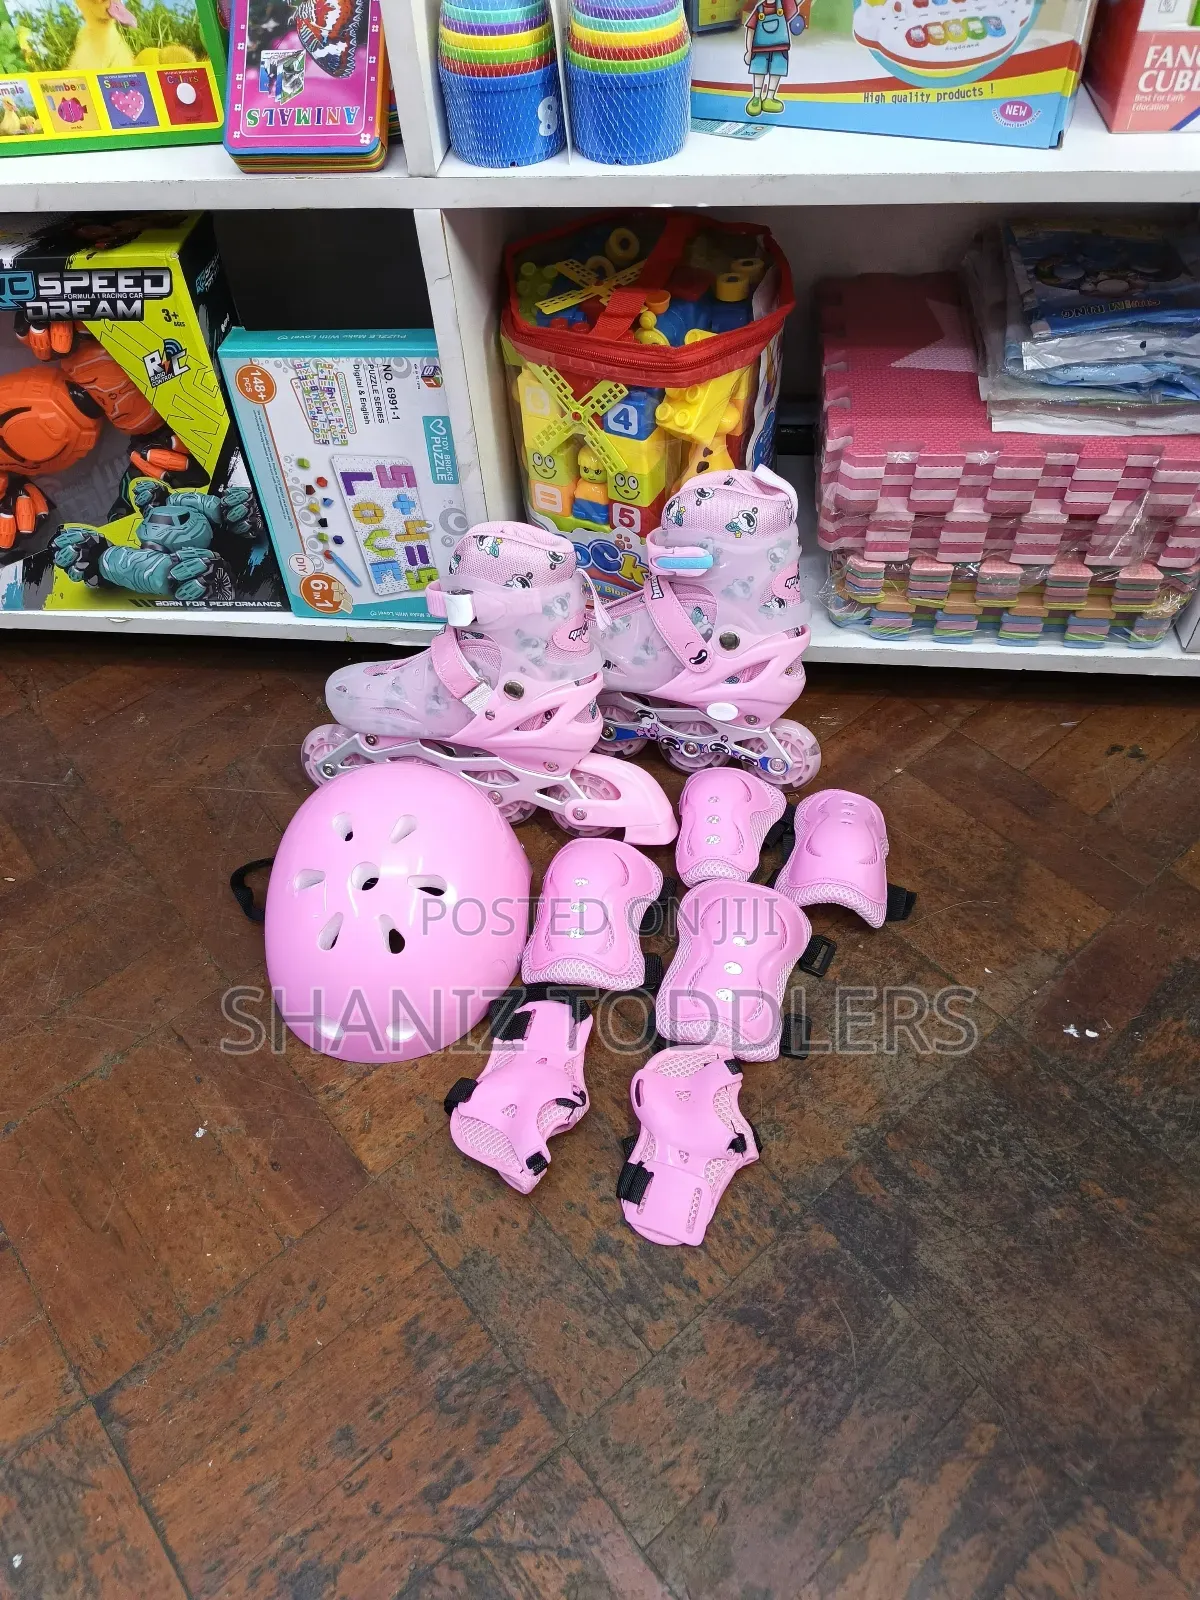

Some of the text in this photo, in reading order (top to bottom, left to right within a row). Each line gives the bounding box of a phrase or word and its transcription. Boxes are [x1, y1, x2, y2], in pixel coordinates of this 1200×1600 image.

[1144, 44, 1200, 69] FAN
[863, 92, 885, 104] High
[891, 91, 931, 104] quality
[936, 86, 984, 102] products
[1134, 93, 1151, 102] Best
[246, 106, 361, 128] ANIMALS
[537, 95, 558, 137] 8
[1005, 104, 1028, 117] NEW
[1131, 103, 1170, 112] Education
[38, 270, 171, 296] SPEED
[26, 300, 142, 320] DREAM
[162, 308, 179, 323] 3+
[150, 371, 165, 382] RADIO
[152, 373, 174, 387] CONTROL
[242, 377, 253, 393] PCS
[250, 369, 267, 401] 148+
[353, 364, 363, 392] Digital
[360, 397, 371, 425] English
[368, 364, 385, 424] PUZZLE SERIES
[382, 363, 401, 420] NO. 6991-1
[612, 407, 633, 431] 4
[430, 436, 447, 481] PUZZLE
[440, 436, 454, 481] TOY BRICKS
[618, 507, 636, 528] 5
[295, 557, 308, 574] DIY
[309, 579, 334, 608] 6 IN 1
[604, 585, 631, 597] Bloc
